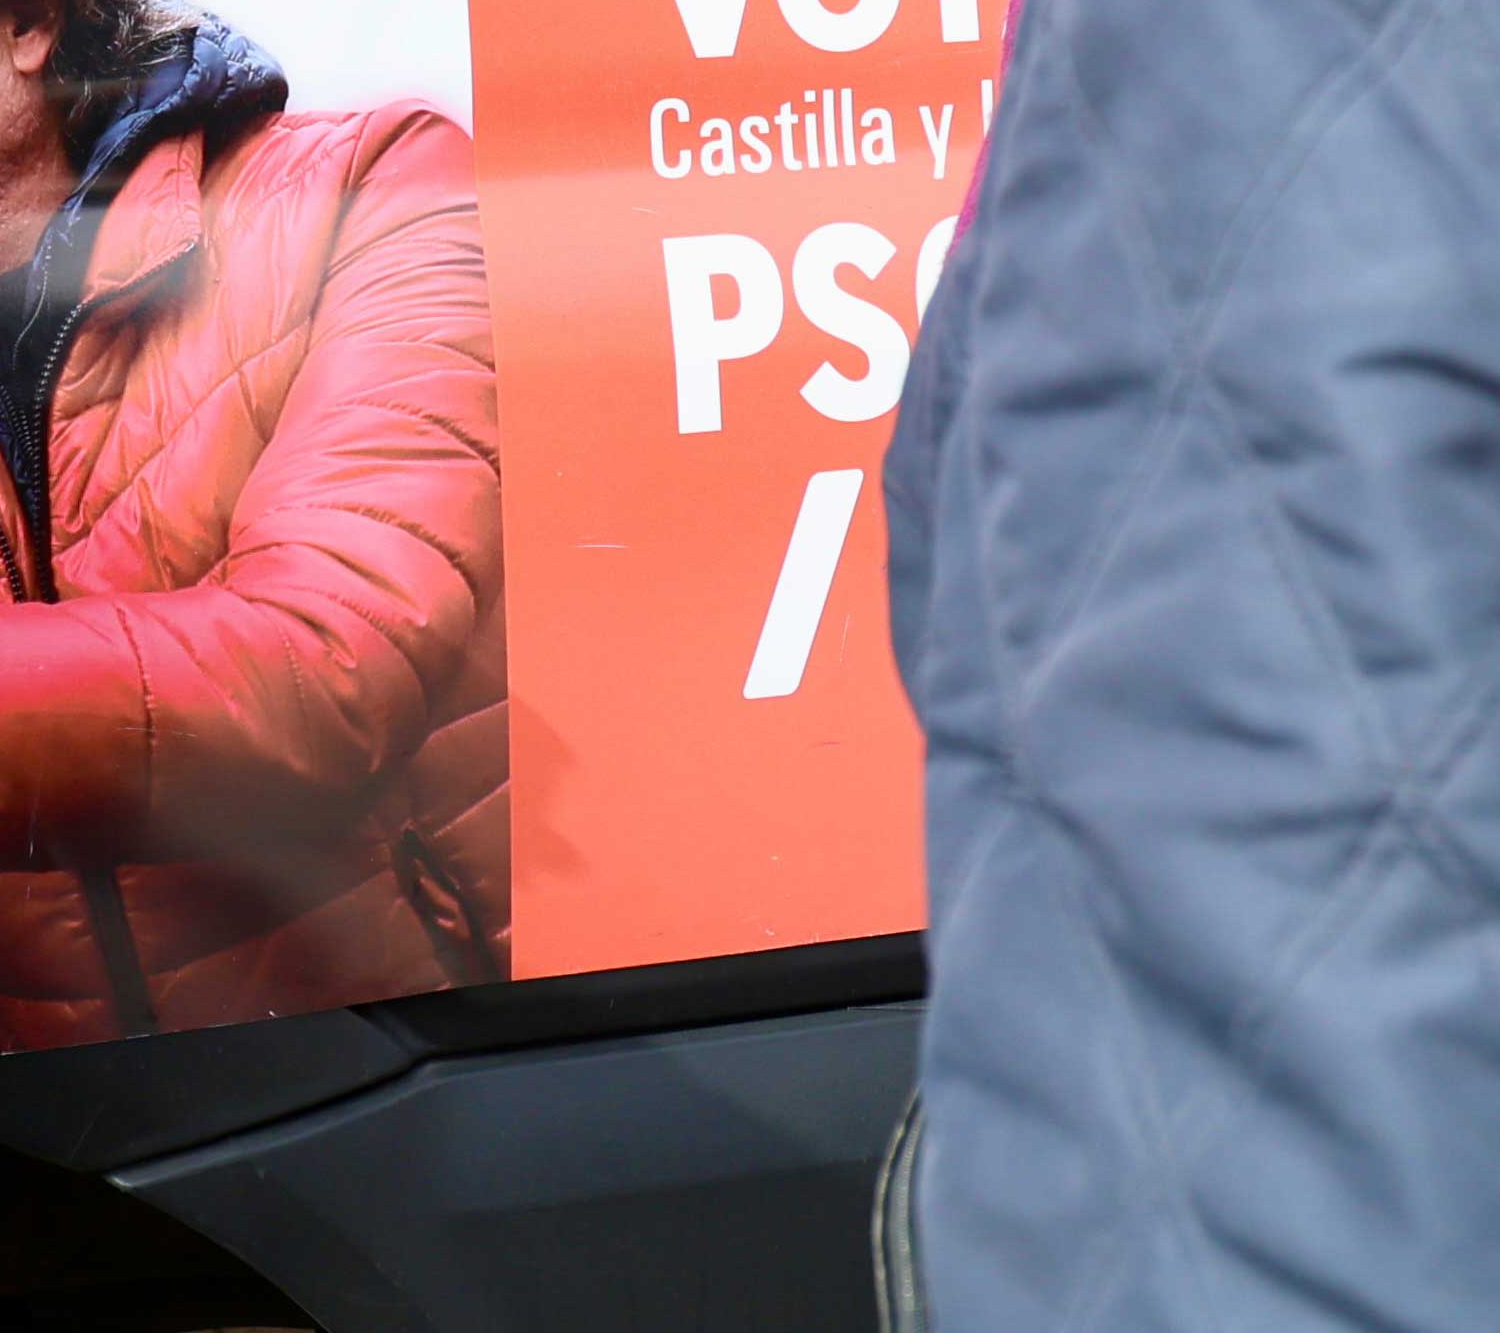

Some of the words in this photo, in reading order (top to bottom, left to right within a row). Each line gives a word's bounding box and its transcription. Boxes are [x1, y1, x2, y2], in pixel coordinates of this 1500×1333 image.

[650, 88, 895, 179] Castilla
[919, 104, 954, 180] y
[662, 215, 960, 434] PS
